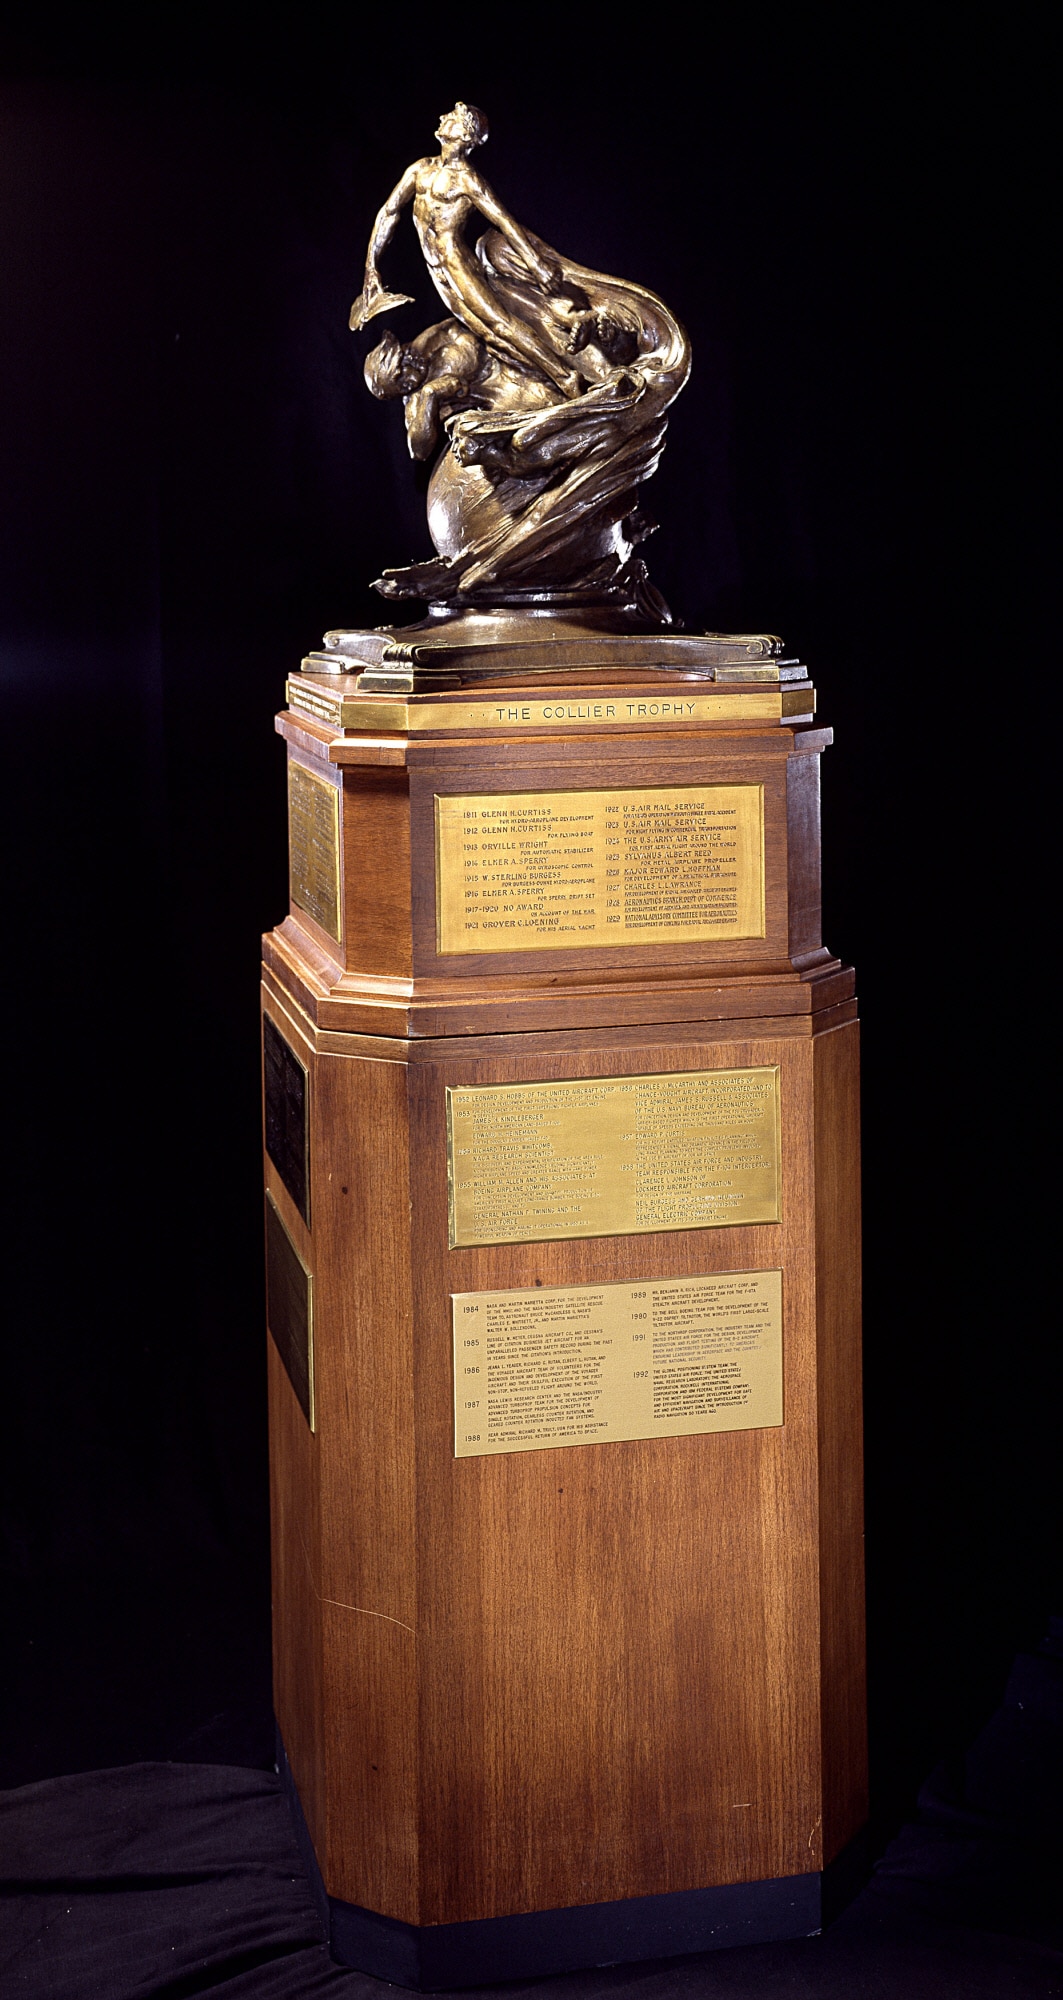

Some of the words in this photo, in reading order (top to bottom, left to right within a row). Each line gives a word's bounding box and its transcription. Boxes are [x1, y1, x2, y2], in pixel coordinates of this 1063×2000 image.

[496, 706, 531, 720] THE
[542, 704, 616, 719] COLLIER
[627, 702, 697, 716] TROPHY
[674, 802, 705, 810] SERVICE
[654, 819, 672, 827] MAIL
[675, 818, 707, 826] SERVICE
[624, 837, 637, 845] THE
[676, 834, 688, 842] AIR
[690, 833, 721, 842] SERVICE
[482, 842, 516, 850] ORVILLE
[519, 841, 548, 849] WRIGHT
[664, 850, 691, 858] ALBERT
[482, 859, 509, 867] ELMER
[650, 866, 680, 874] EDWARD
[491, 873, 527, 881] STERLING
[529, 872, 561, 880] BURGESS
[624, 882, 655, 891] CHARLES
[482, 889, 507, 897] ELMER
[516, 903, 544, 912] AWARD
[482, 920, 515, 929] GROVER
[635, 1083, 660, 1091] CHARLES
[711, 1077, 744, 1086] ASSOCIATES
[471, 1094, 497, 1102] LEONARD
[572, 1087, 598, 1095] AIRCRAFT
[473, 1179, 496, 1188] WILLIAM
[631, 1291, 646, 1299] 1989
[463, 1305, 479, 1314] 1984
[632, 1334, 646, 1342] 1991
[463, 1339, 480, 1348] 1985
[464, 1366, 480, 1375] 1986
[464, 1401, 480, 1409] 1987
[465, 1434, 480, 1443] 1988
